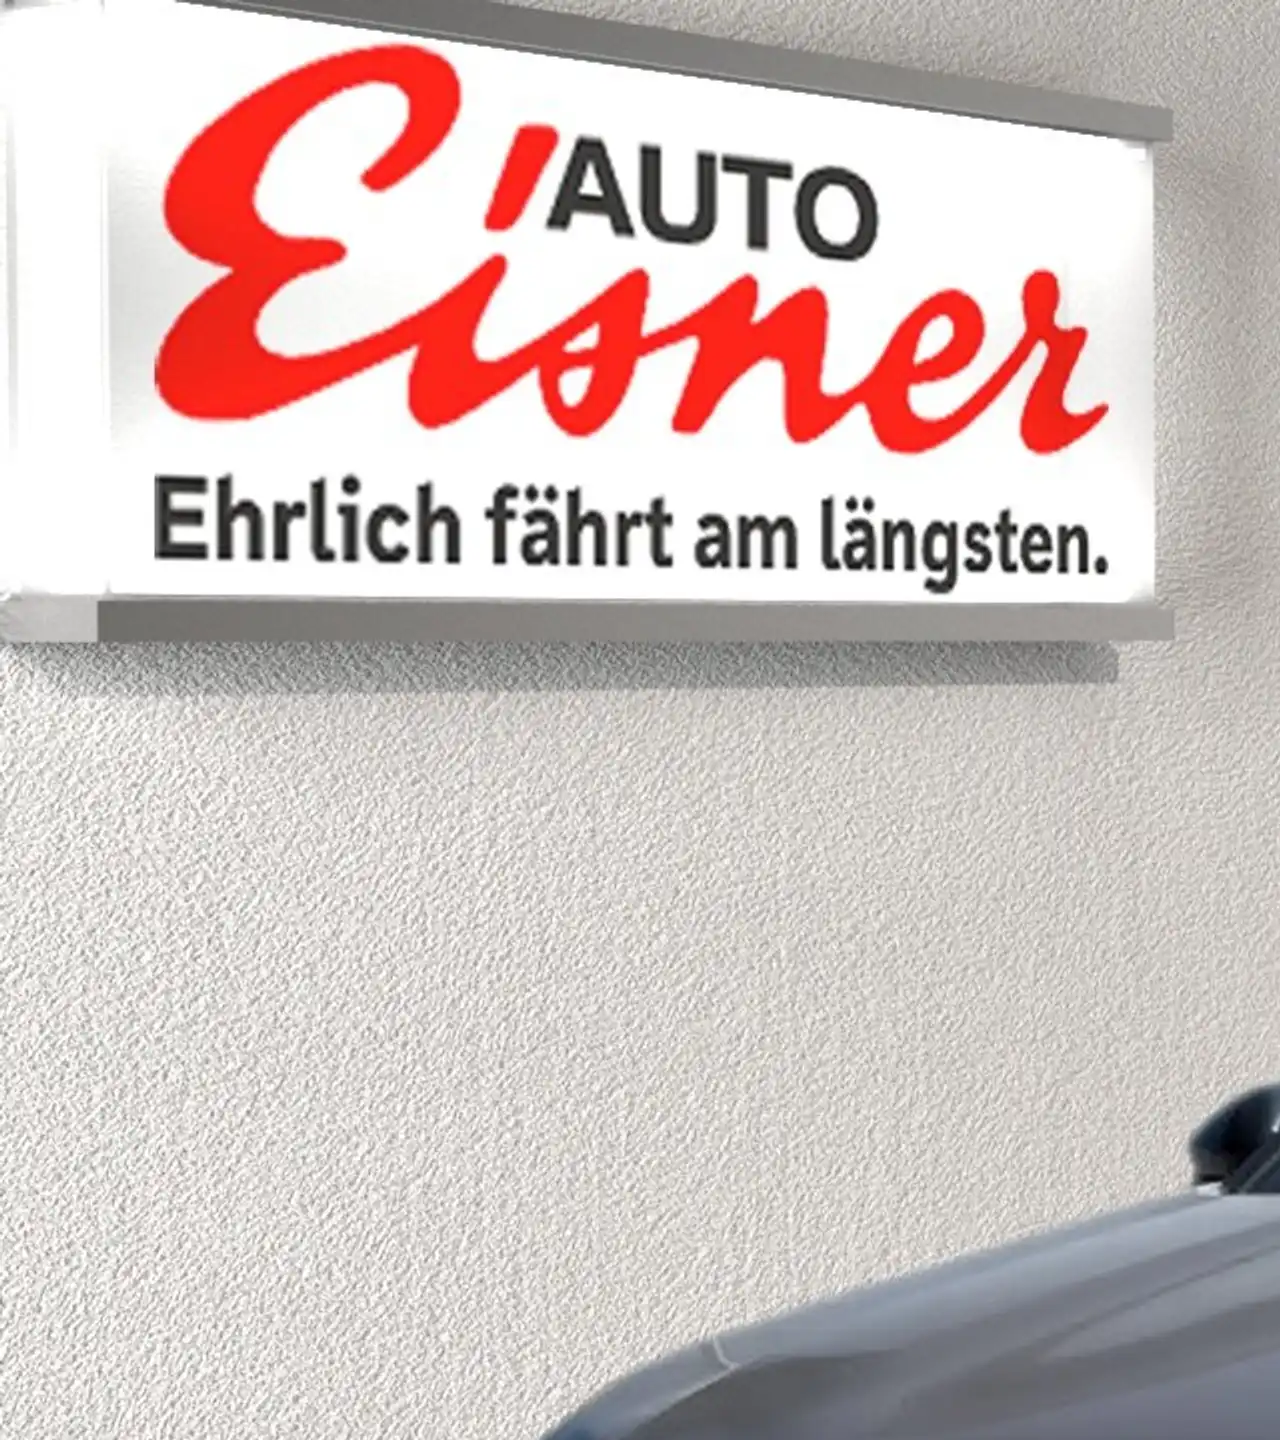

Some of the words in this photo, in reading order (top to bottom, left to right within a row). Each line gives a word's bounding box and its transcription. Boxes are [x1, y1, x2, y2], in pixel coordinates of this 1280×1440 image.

[156, 44, 1108, 455] Eisner
[546, 136, 879, 262] AUTO
[155, 475, 461, 564] Ehrlich
[485, 484, 673, 568] fährt
[694, 513, 798, 570] am
[821, 496, 1108, 594] längsten.
